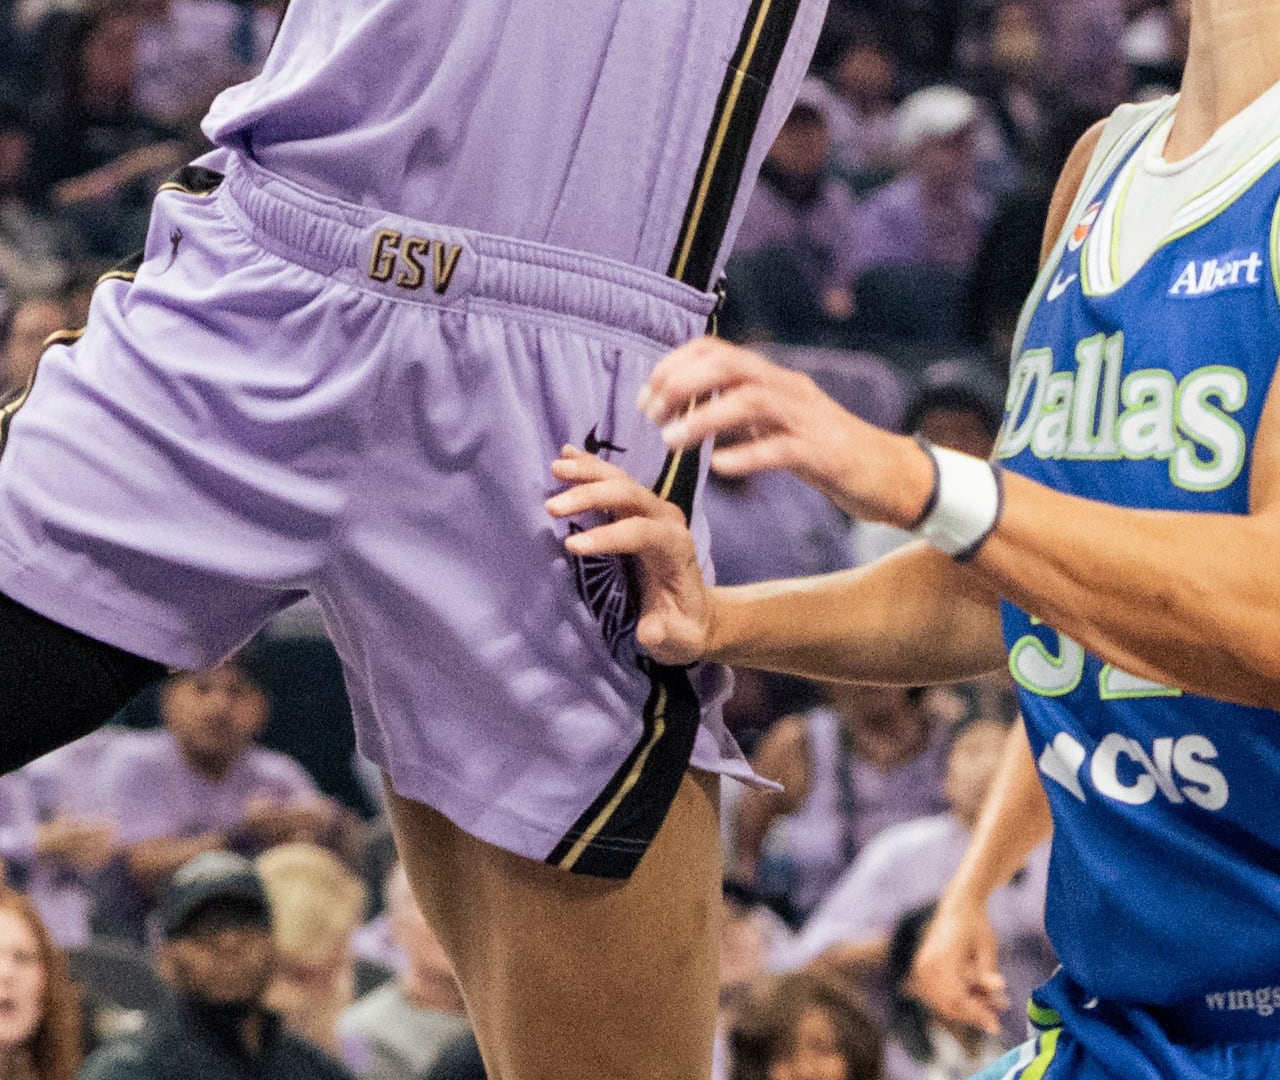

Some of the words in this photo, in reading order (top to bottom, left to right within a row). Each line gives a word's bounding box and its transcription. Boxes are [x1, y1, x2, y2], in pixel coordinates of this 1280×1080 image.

[369, 228, 463, 295] GSV
[1167, 250, 1263, 295] Albert
[996, 329, 1249, 493] Dallas
